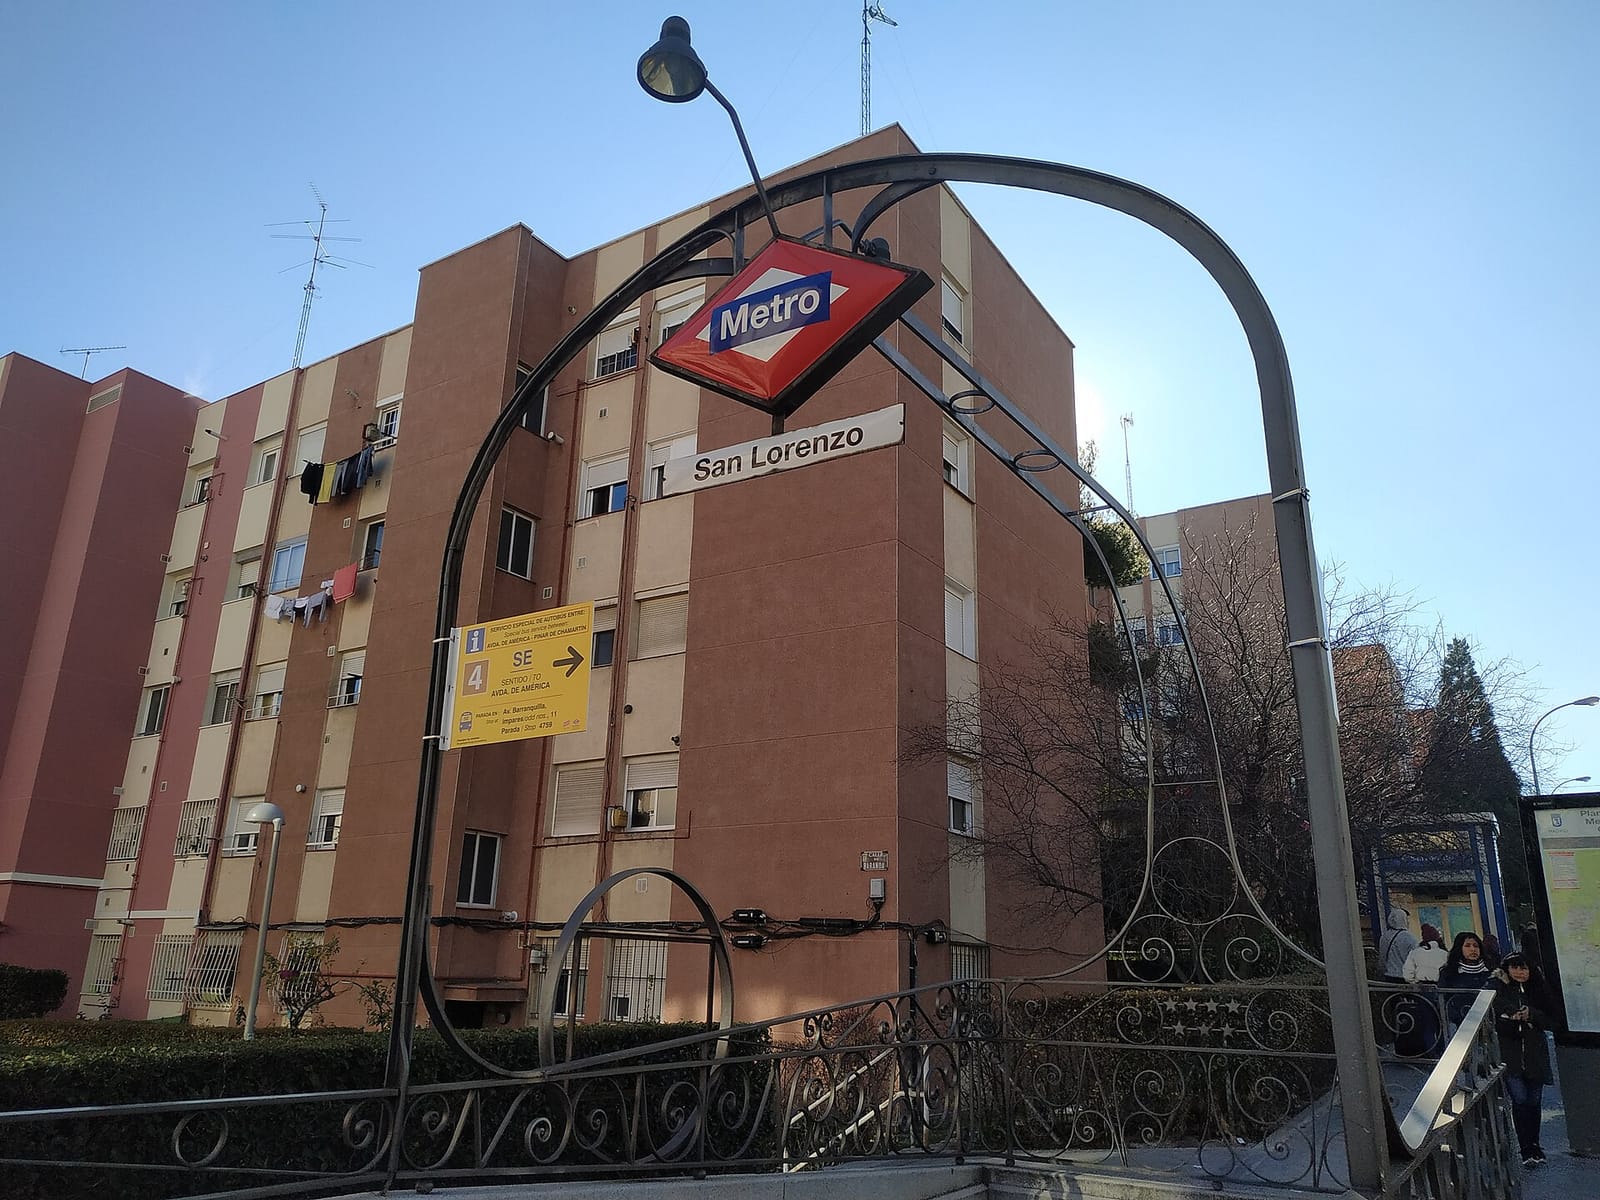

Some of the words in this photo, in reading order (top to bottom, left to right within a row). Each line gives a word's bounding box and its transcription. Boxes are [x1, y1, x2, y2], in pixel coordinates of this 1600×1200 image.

[719, 288, 820, 341] Metro
[693, 453, 742, 481] San
[751, 425, 864, 469] Lorenzo
[490, 624, 512, 633] SERVICIO
[513, 619, 535, 628] ESPECIAL
[504, 629, 520, 638] Special
[521, 627, 530, 635] bus
[531, 624, 547, 633] service
[533, 631, 548, 640] PINAR
[549, 630, 557, 638] DE
[513, 649, 533, 667] SE
[468, 664, 483, 690] 4
[501, 675, 528, 687] SENTIDO
[533, 673, 542, 681] TO
[491, 689, 509, 698] AVDA.
[511, 686, 520, 694] DE
[521, 681, 551, 693] AMÉRICA
[501, 726, 520, 735] Parada
[524, 724, 537, 732] Stop
